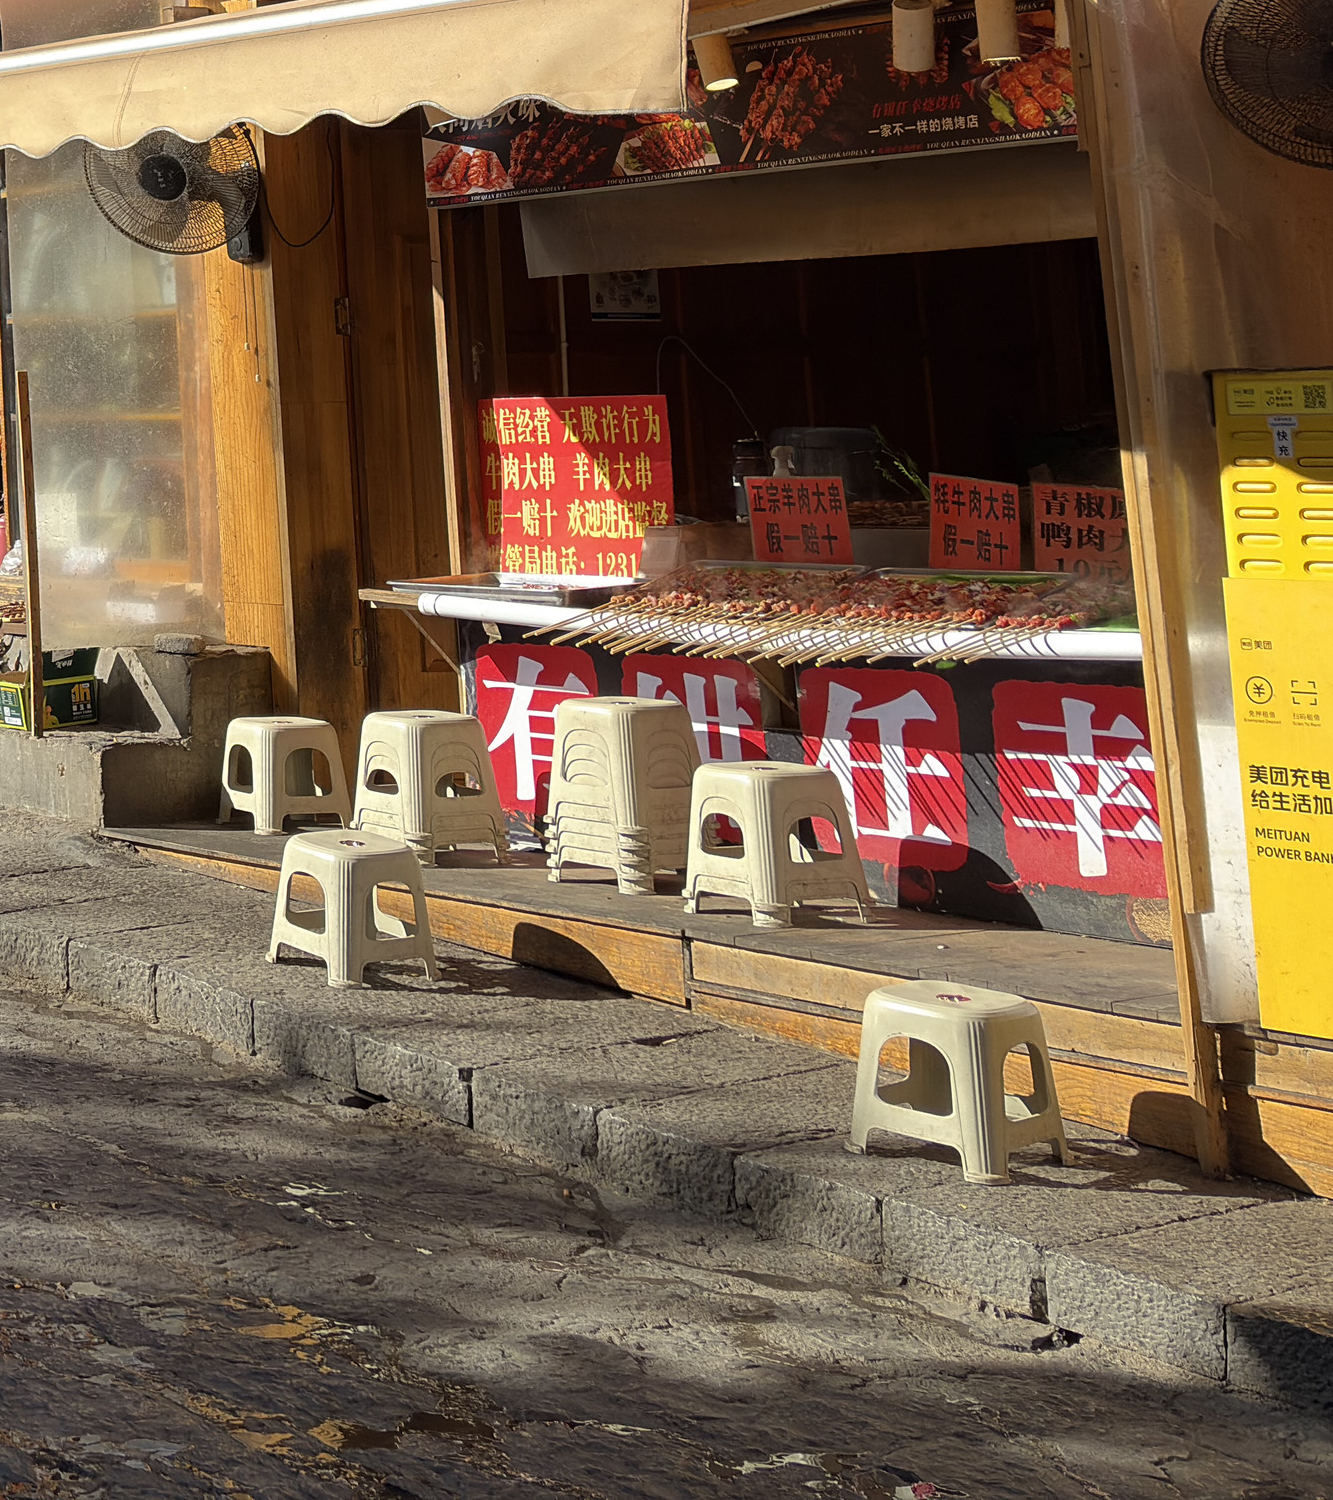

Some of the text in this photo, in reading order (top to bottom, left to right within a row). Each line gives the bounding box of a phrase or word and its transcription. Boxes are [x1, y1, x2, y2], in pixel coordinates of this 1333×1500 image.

[868, 114, 979, 138] 一家不一样的烧烤店
[482, 404, 661, 445] 诚信经营 无欺诈行为
[1276, 430, 1290, 456] 快充
[485, 452, 653, 492] 牛肉大串 羊肉大串
[751, 482, 843, 516] 正宗羊肉大串
[934, 481, 1017, 525] 牦牛肉大串
[486, 498, 669, 539] 假一赔十 欢迎进店监督
[765, 521, 839, 556] 假一赔十
[943, 522, 1010, 566] 假一赔十
[1254, 640, 1273, 650] 美团
[1249, 764, 1332, 790] 美团充电
[1250, 789, 1333, 815] 给生活加
[1255, 827, 1311, 843] MEITUAN
[1257, 845, 1302, 861] POWER
